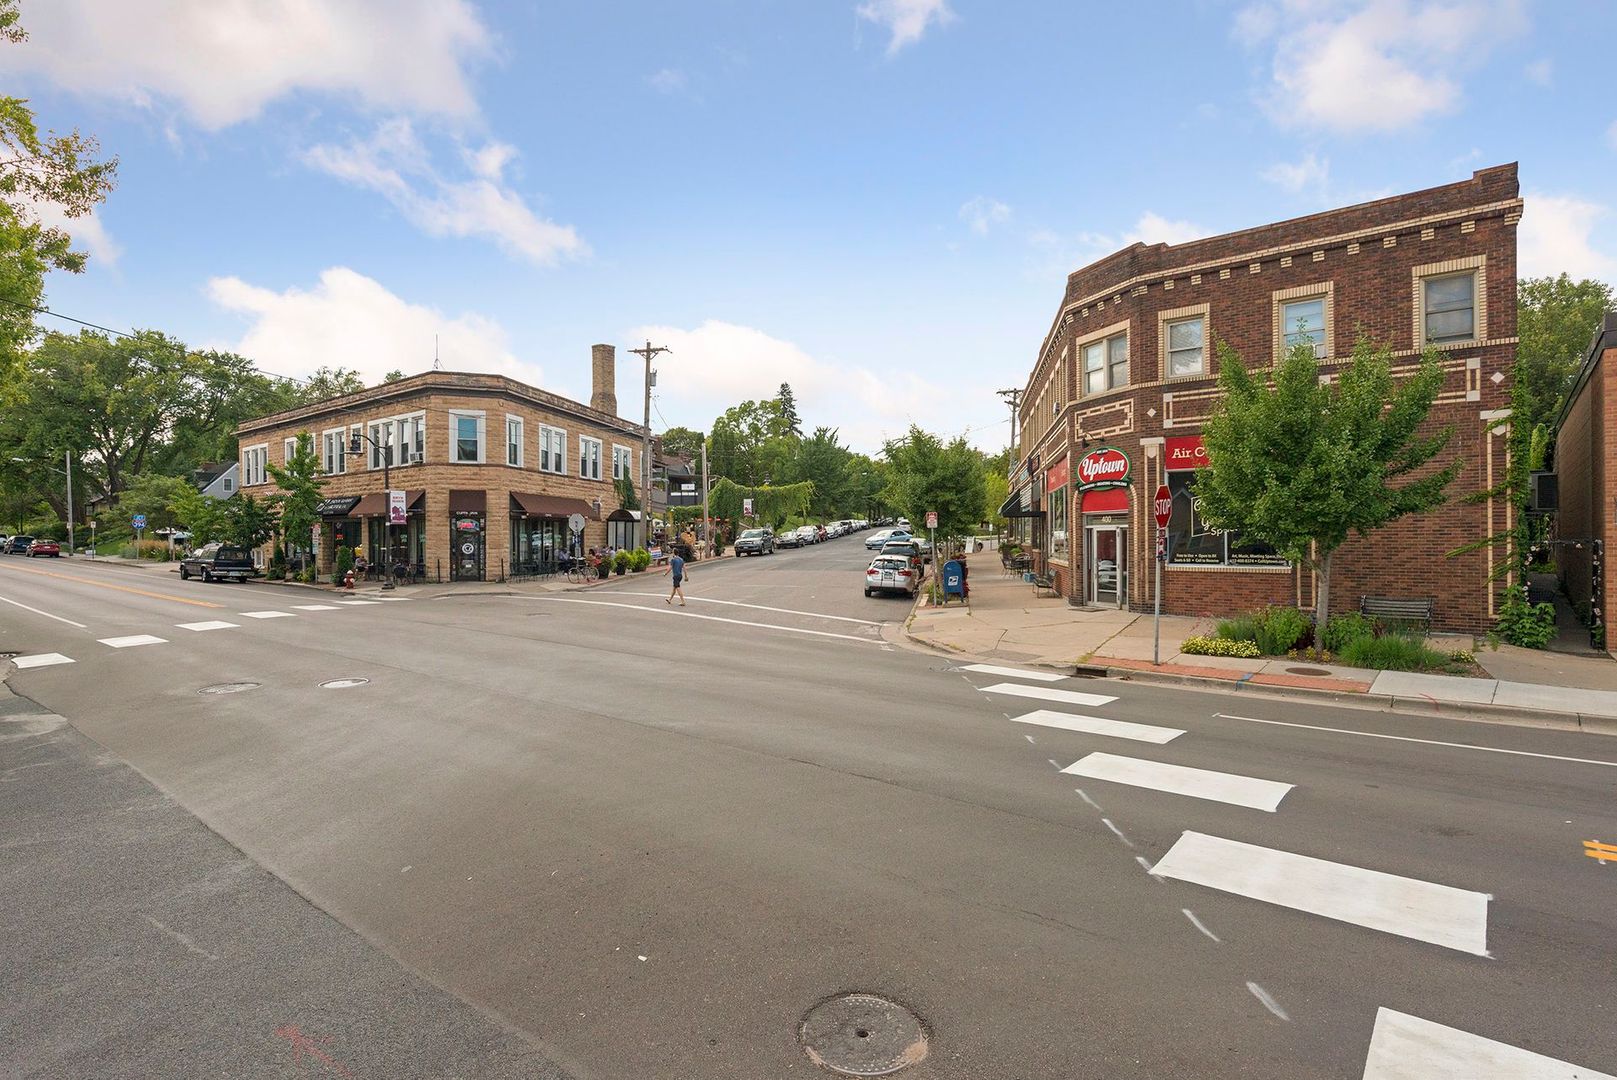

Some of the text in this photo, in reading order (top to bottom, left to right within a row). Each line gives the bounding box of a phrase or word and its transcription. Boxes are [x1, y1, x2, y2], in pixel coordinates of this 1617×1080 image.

[1172, 447, 1191, 459] Air
[1082, 457, 1125, 481] Uptown
[1155, 499, 1171, 516] STOP
